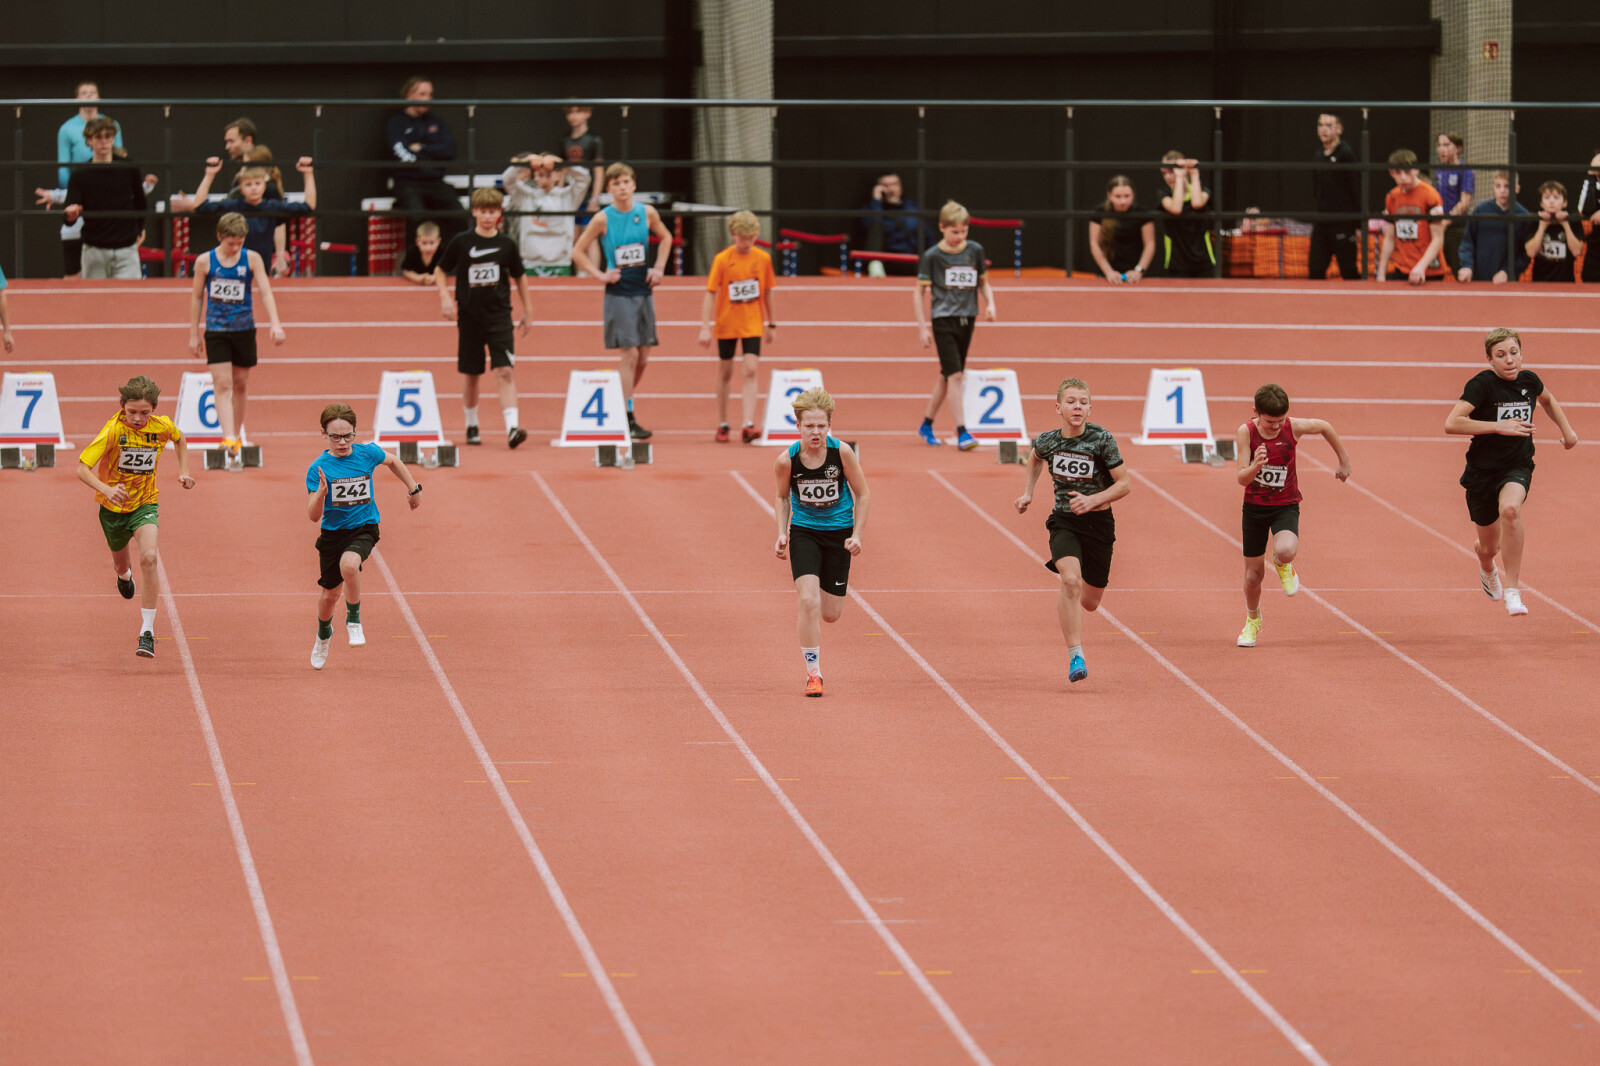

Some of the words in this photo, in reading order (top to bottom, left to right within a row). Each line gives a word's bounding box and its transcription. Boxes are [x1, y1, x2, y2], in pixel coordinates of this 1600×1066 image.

[473, 268, 496, 280] 221
[950, 271, 973, 283] 282
[214, 284, 240, 297] 265
[733, 284, 757, 297] 368
[16, 390, 43, 429] 7
[198, 390, 220, 429] 6
[396, 388, 422, 426] 5
[581, 387, 609, 426] 4
[979, 386, 1005, 425] 2
[1166, 386, 1184, 425] 1
[1500, 408, 1530, 421] 483
[144, 432, 158, 443] 14
[122, 453, 153, 467] 254
[1056, 458, 1090, 476] 469
[1255, 469, 1282, 484] 201
[335, 482, 368, 499] 242
[801, 484, 836, 499] 406
